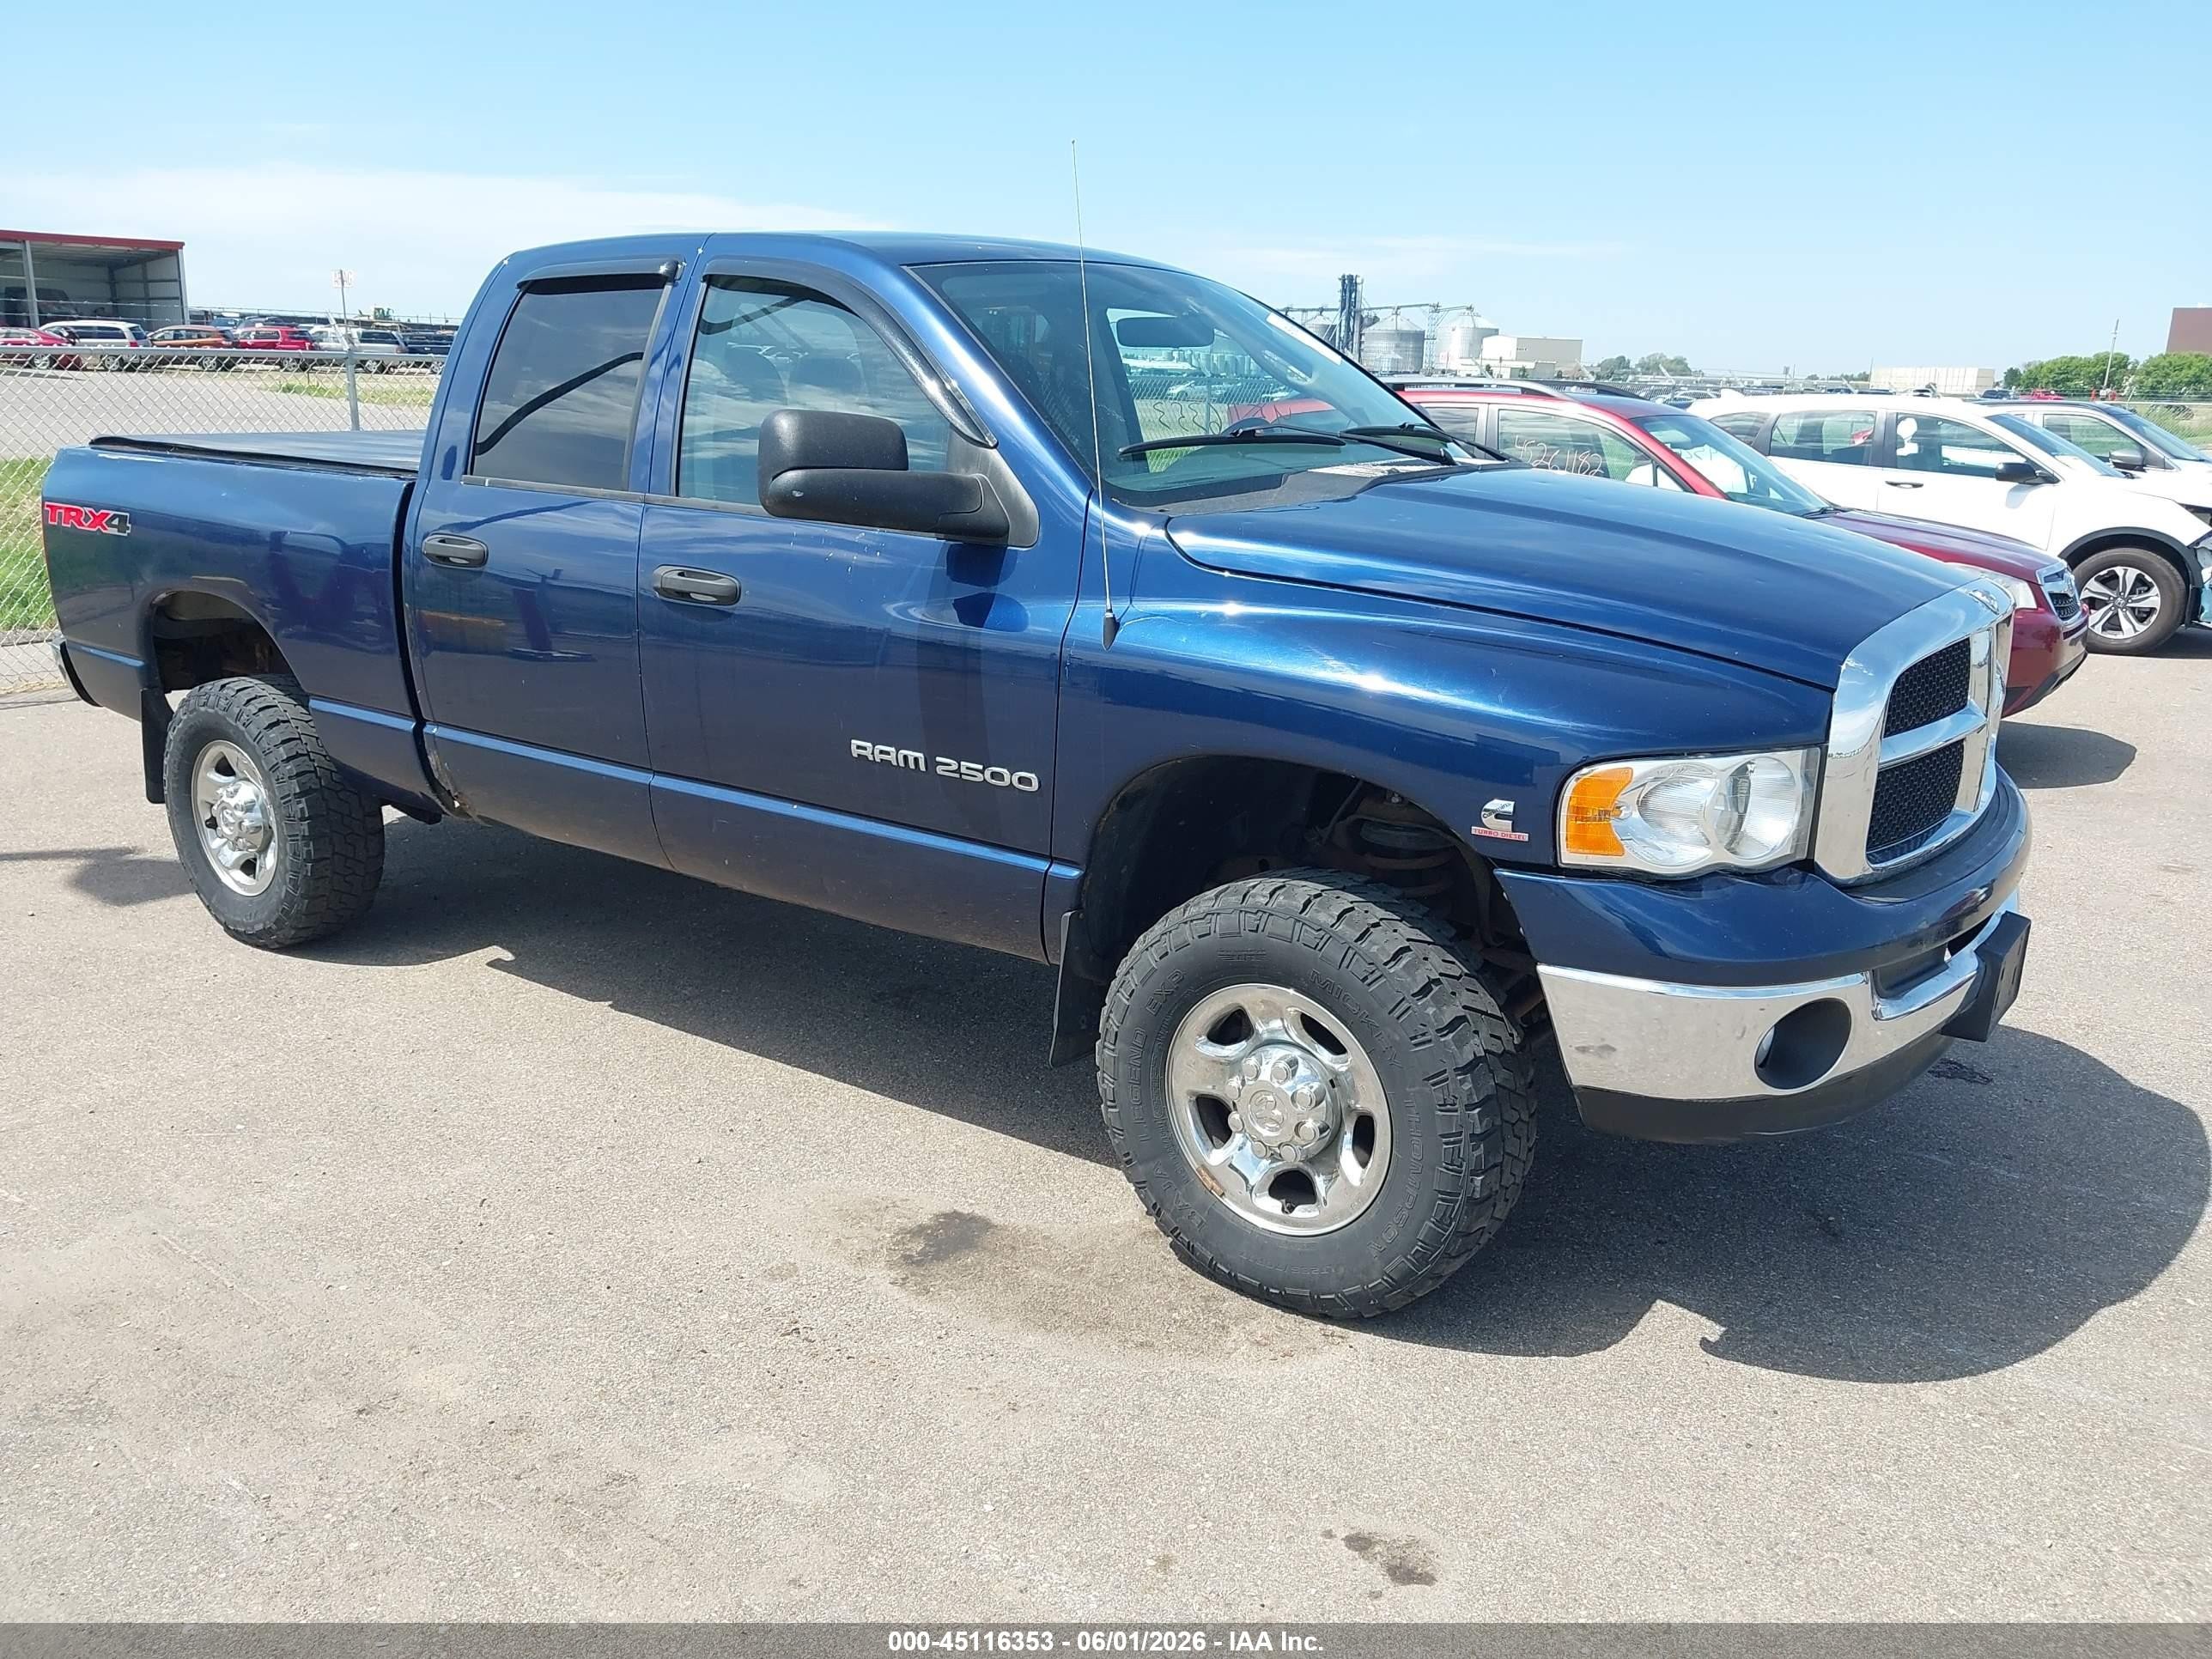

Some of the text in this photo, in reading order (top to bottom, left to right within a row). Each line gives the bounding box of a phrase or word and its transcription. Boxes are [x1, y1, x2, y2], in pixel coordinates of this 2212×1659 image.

[1516, 435, 1604, 477] 45261182
[45, 501, 131, 537] TRX4
[850, 738, 1040, 792] RAM 2500
[1482, 802, 1511, 819] Cummins
[1474, 828, 1499, 836] TURBO
[1366, 1098, 1424, 1259] THOMPSON
